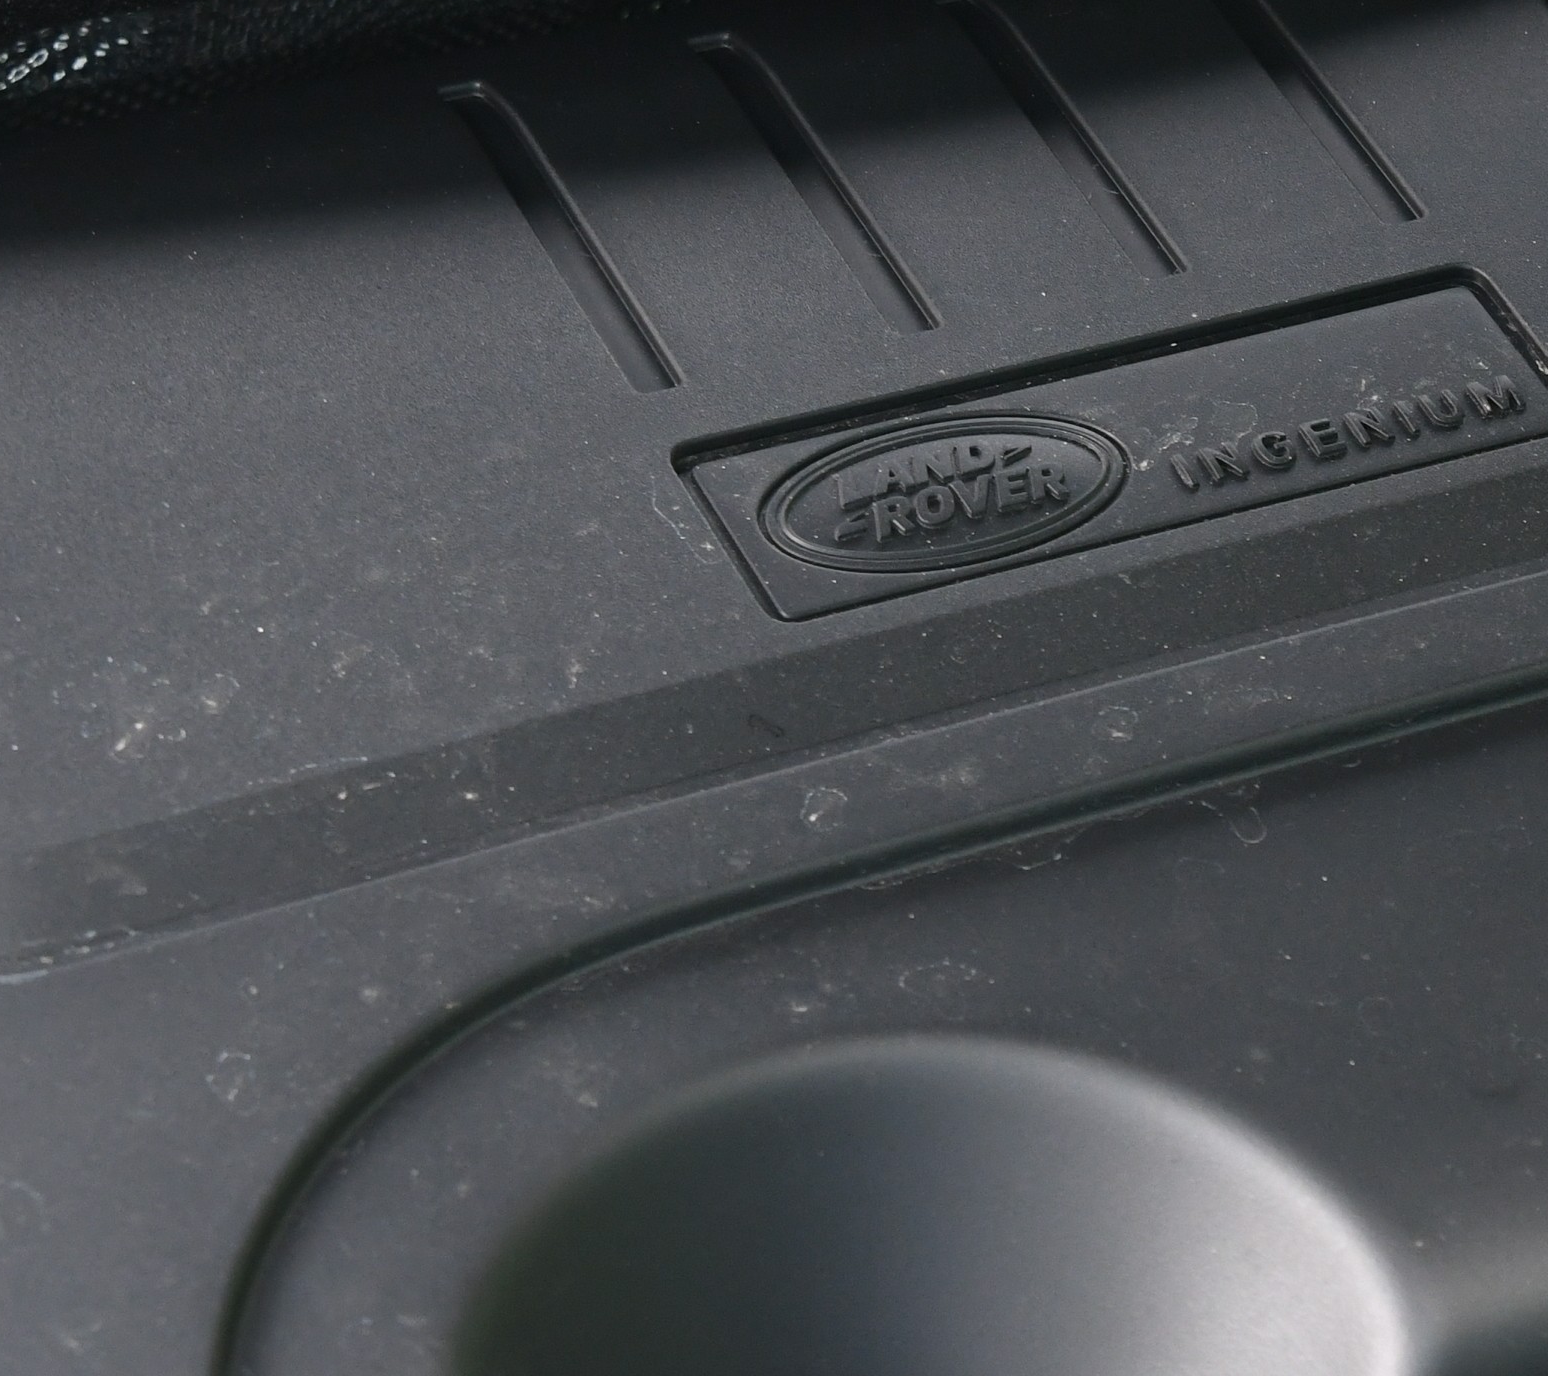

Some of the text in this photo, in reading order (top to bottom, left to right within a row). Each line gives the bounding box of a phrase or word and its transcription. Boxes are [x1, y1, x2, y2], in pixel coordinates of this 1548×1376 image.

[835, 439, 998, 508] LAND
[1169, 374, 1527, 493] INGENIUM
[873, 456, 1071, 544] ROVER
